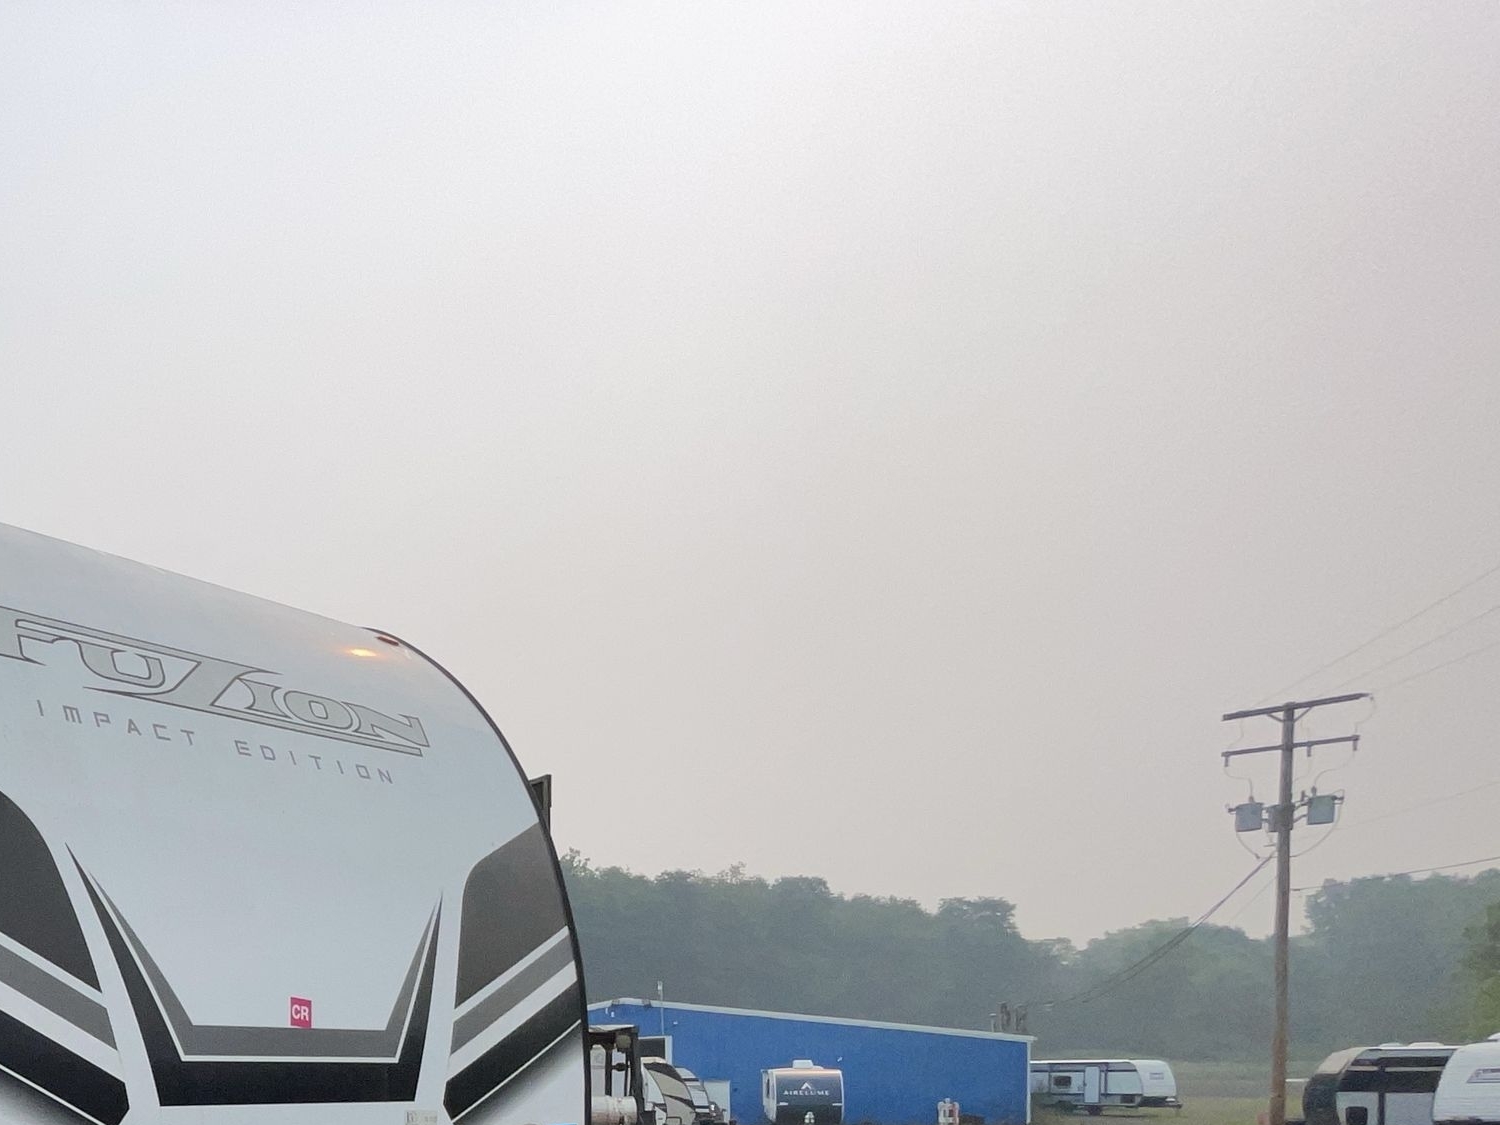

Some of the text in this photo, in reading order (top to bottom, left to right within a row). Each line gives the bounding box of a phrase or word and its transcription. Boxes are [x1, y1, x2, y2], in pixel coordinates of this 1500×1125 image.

[36, 699, 394, 784] IMPACT EDITION
[291, 1004, 309, 1021] CR
